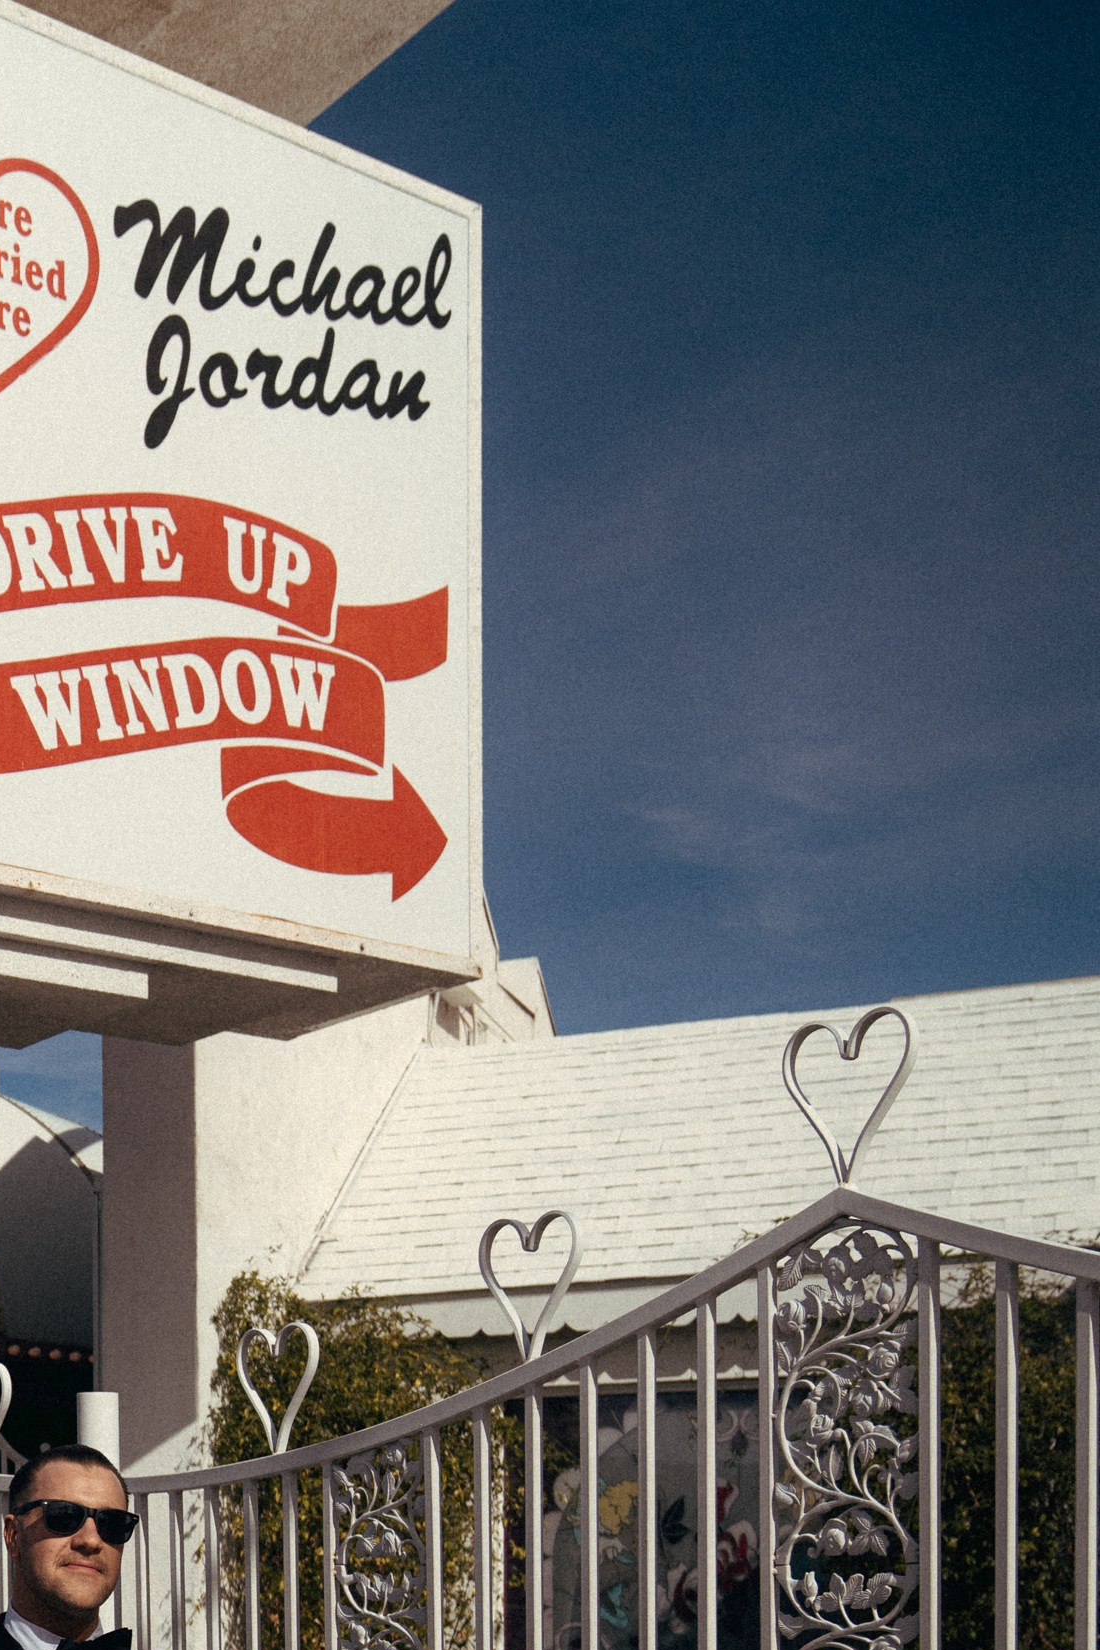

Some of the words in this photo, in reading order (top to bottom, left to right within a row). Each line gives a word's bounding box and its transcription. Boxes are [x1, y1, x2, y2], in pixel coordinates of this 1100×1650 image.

[113, 199, 452, 330] Michael
[143, 314, 431, 450] Jordan
[222, 515, 312, 609] UP
[9, 648, 336, 751] WINDOW
